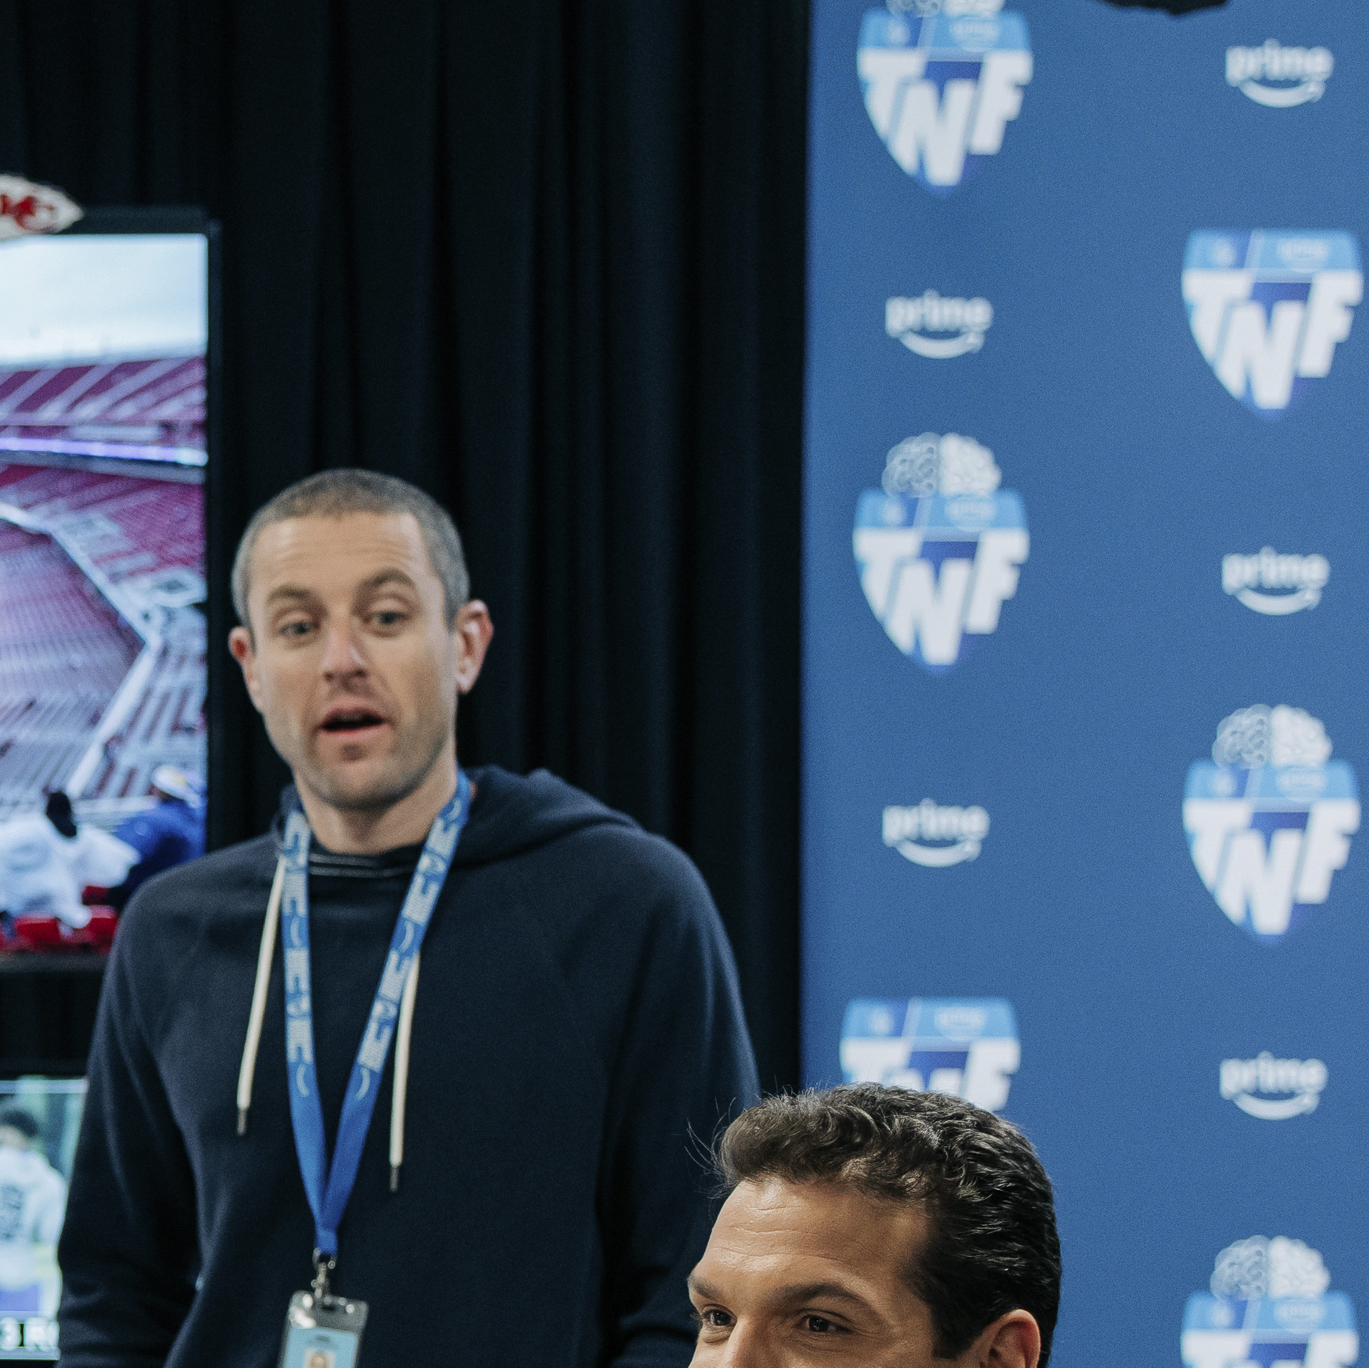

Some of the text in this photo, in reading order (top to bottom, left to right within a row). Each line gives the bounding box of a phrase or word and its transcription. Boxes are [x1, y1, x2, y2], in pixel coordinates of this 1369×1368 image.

[1225, 38, 1333, 87] prime
[857, 48, 1033, 186] TNF
[886, 288, 993, 337] prime
[1181, 268, 1364, 410] TNF
[853, 528, 1030, 666] TNF
[1222, 545, 1330, 594] prime
[882, 798, 990, 847] prime
[1182, 800, 1361, 936] TNF
[840, 1037, 1020, 1111] TF
[1220, 1051, 1328, 1100] prime
